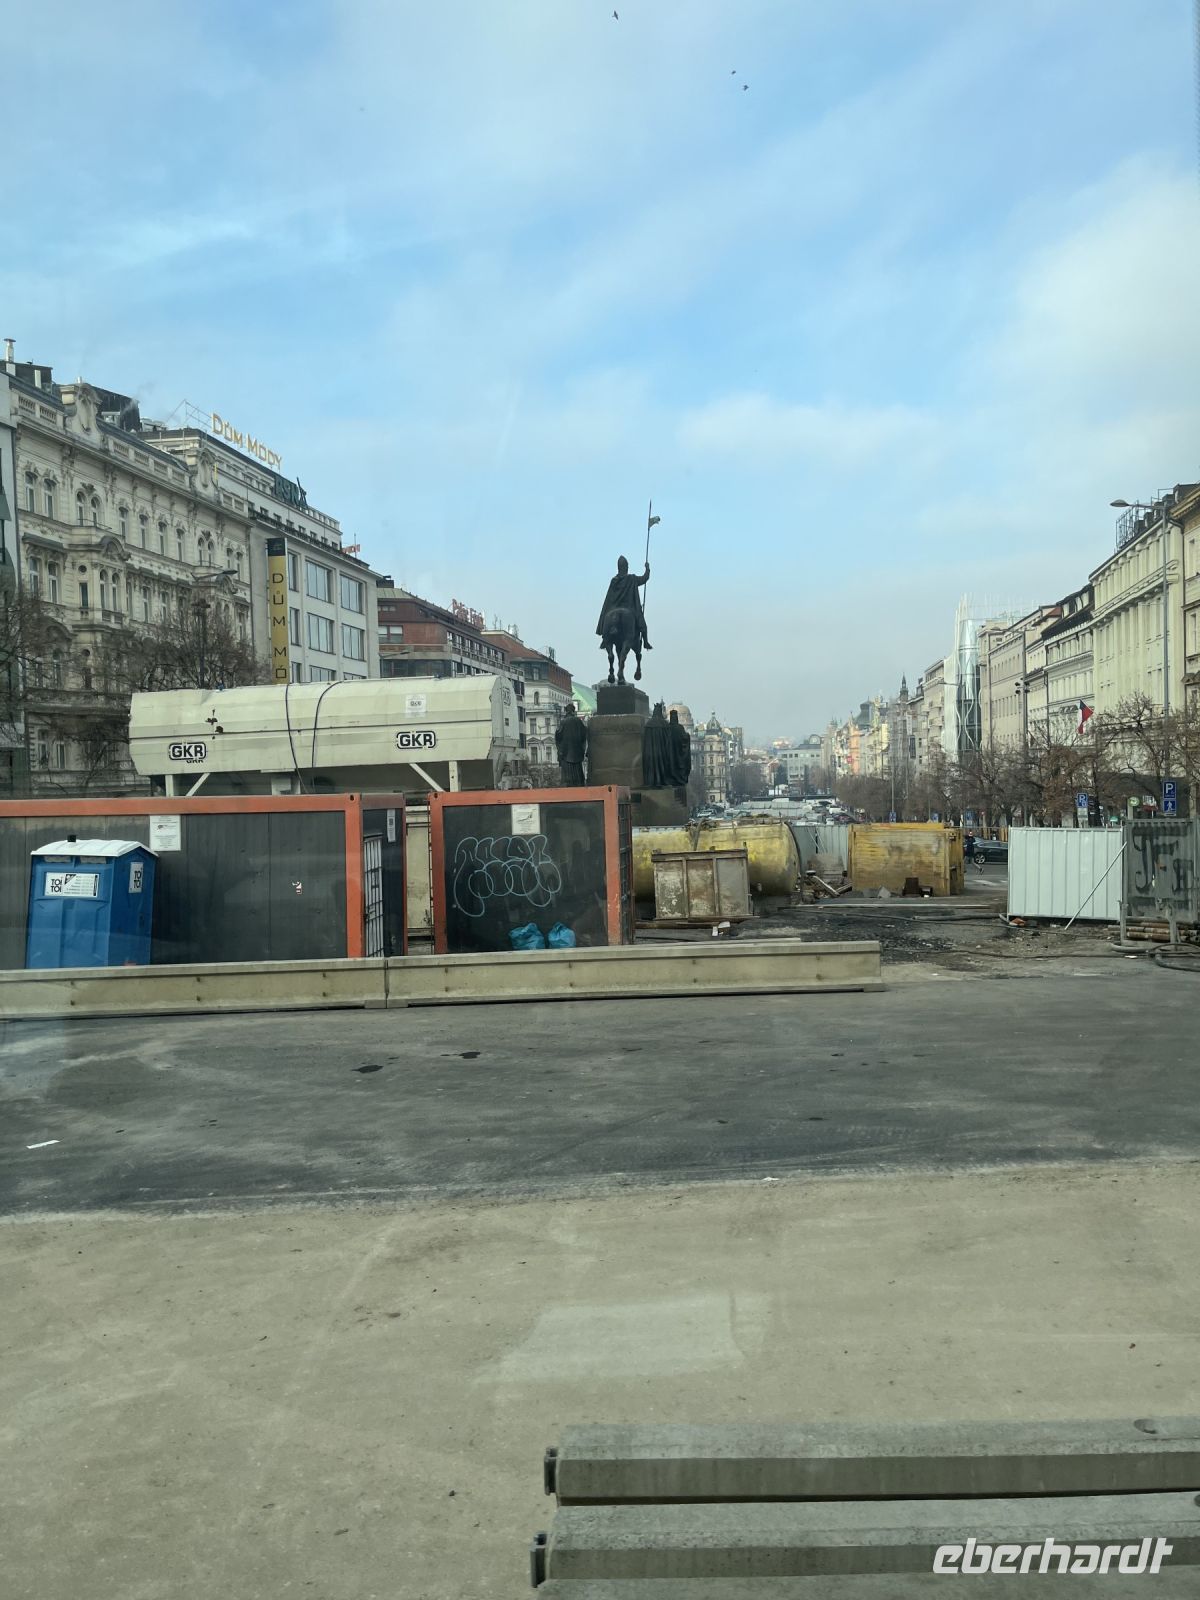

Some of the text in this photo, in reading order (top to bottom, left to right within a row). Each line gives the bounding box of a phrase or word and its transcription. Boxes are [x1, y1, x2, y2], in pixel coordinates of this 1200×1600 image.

[399, 733, 433, 748] GKR
[171, 745, 204, 759] GKR
[1165, 783, 1174, 794] P
